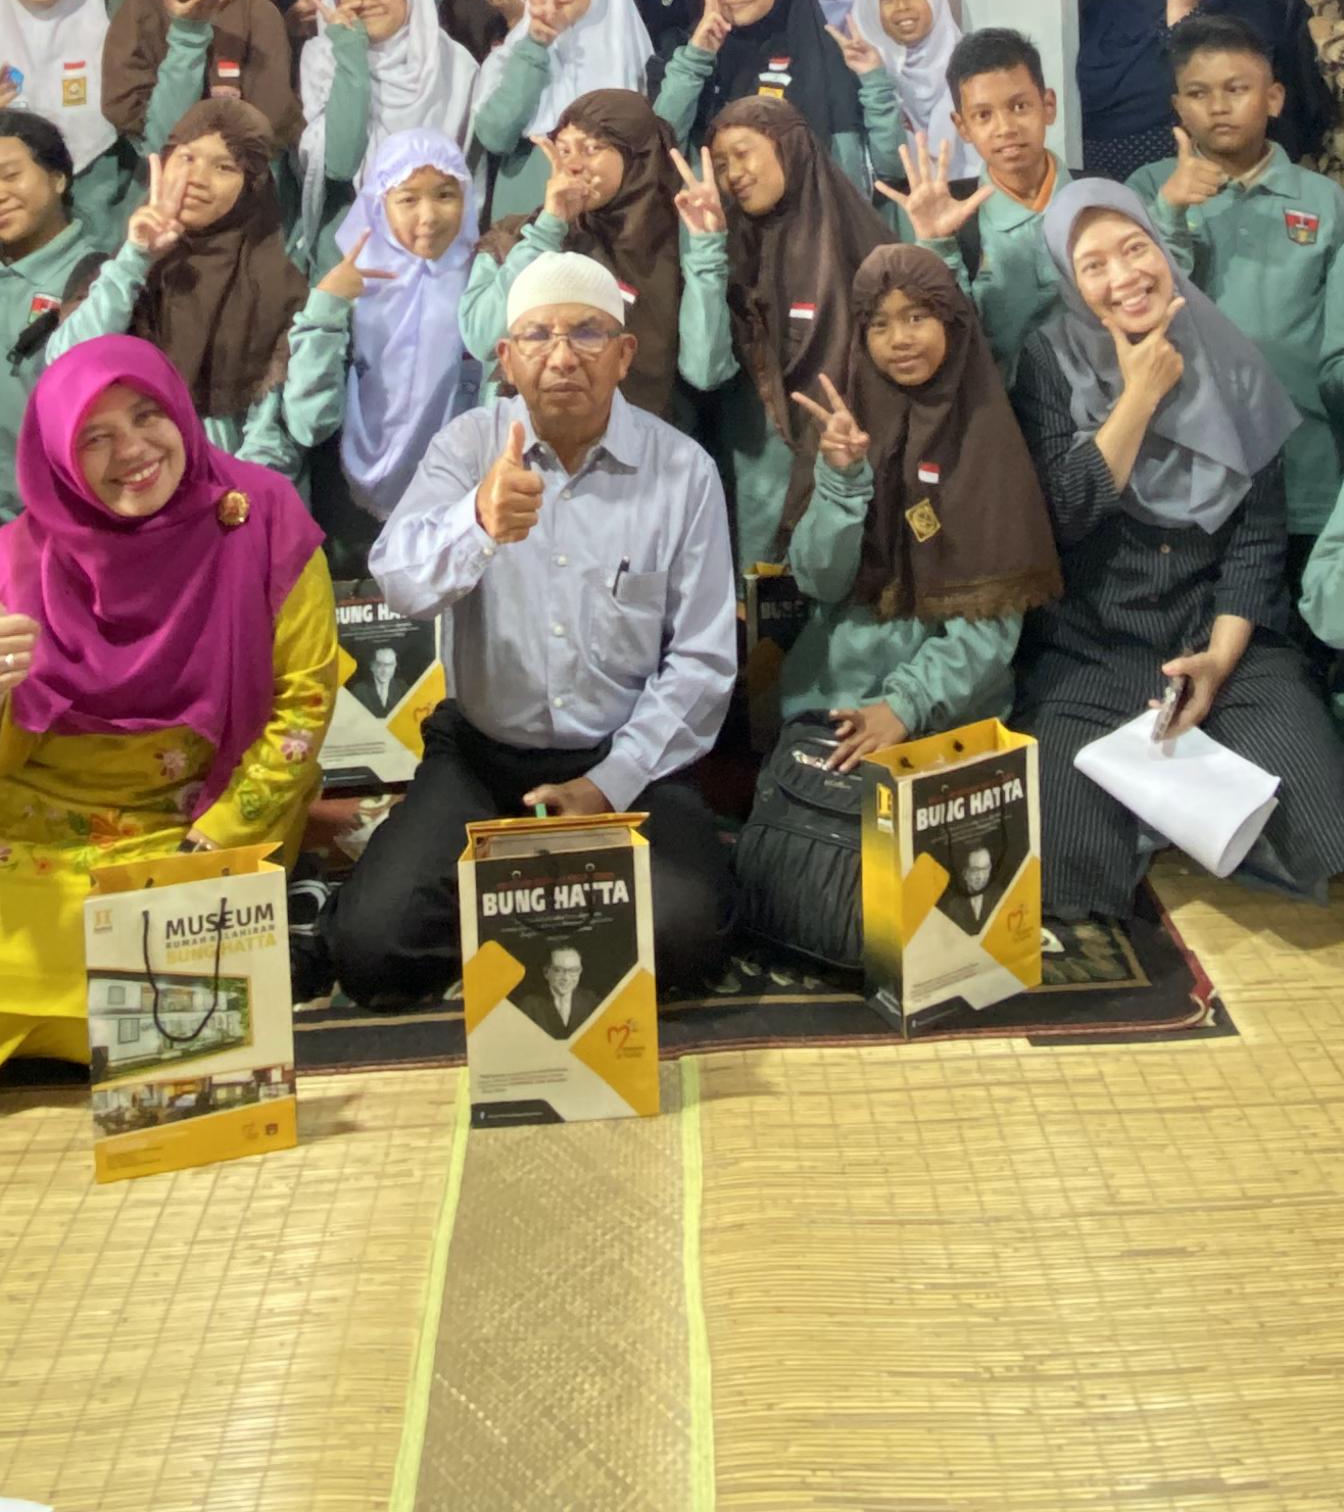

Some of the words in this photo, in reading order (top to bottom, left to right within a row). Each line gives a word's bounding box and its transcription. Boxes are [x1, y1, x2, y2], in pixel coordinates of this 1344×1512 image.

[336, 604, 374, 624] UNG
[916, 797, 965, 832] BUNG
[970, 778, 1024, 816] HATTA
[482, 887, 546, 917] BUNG
[165, 903, 274, 940] MUSEUM
[210, 925, 276, 942] KLAHIRAN
